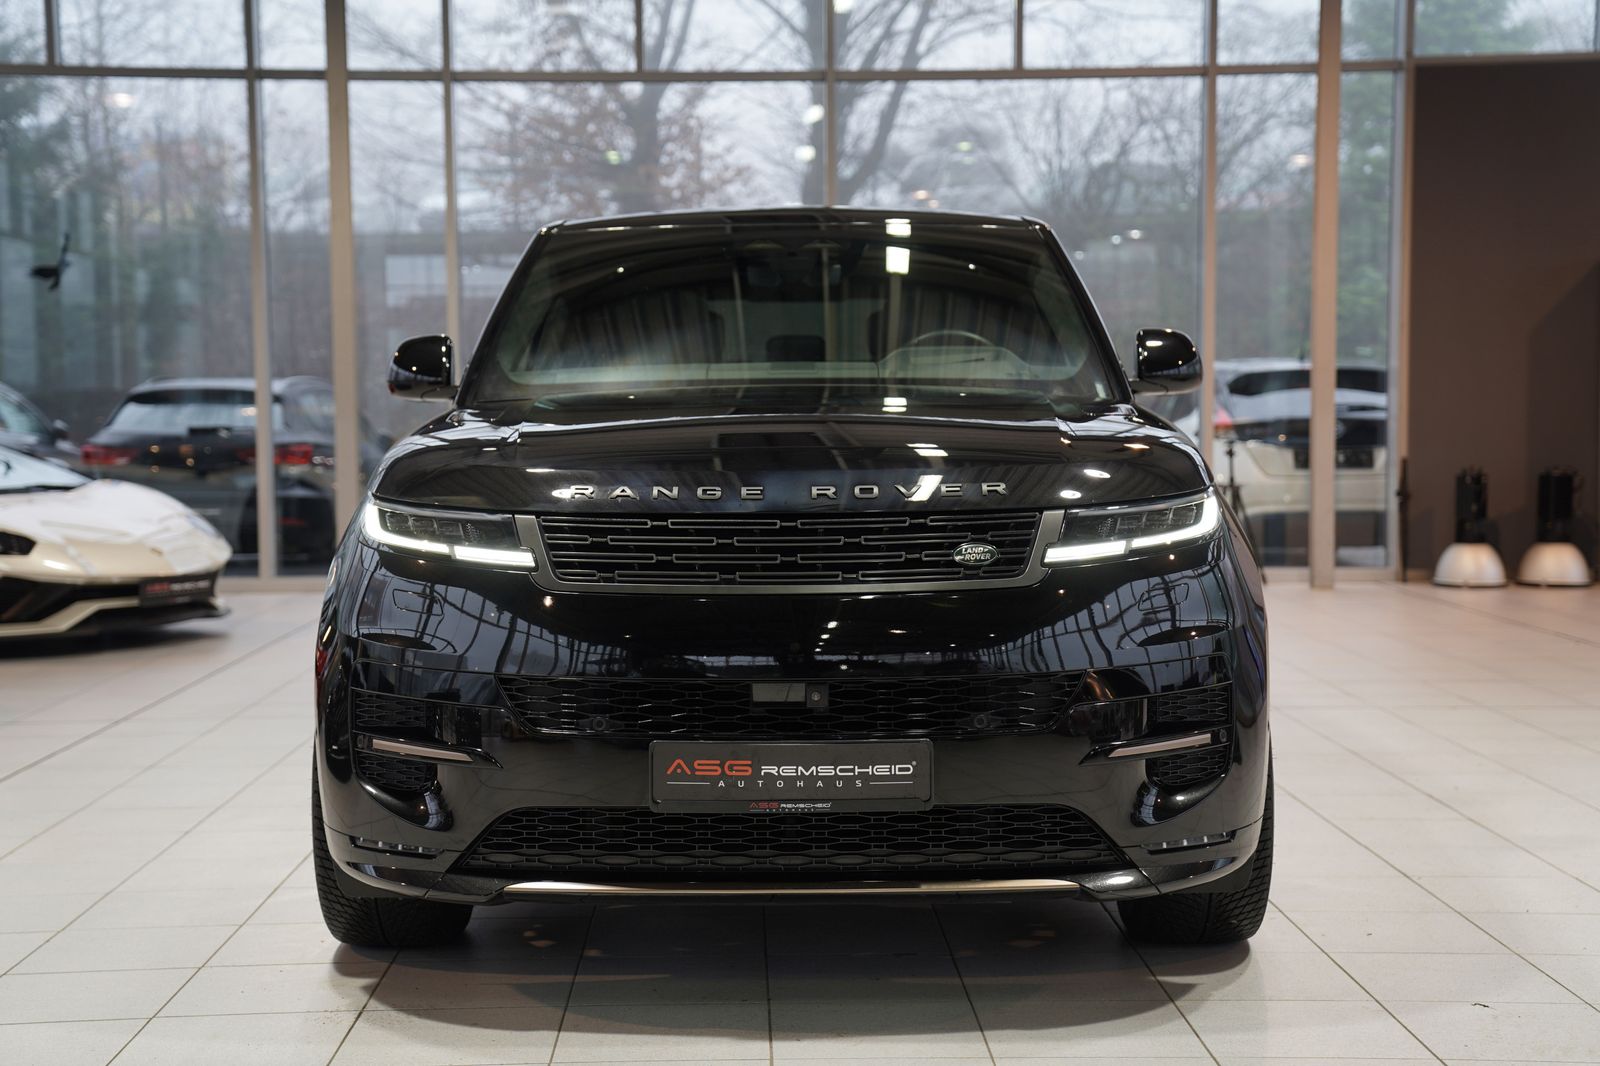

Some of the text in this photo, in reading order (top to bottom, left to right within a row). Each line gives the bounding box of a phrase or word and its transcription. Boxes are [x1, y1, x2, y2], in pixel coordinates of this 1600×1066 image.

[569, 482, 1009, 500] RANGE ROVER
[666, 758, 914, 776] ASG REMSCHEID
[718, 780, 863, 788] AUTOHAUS
